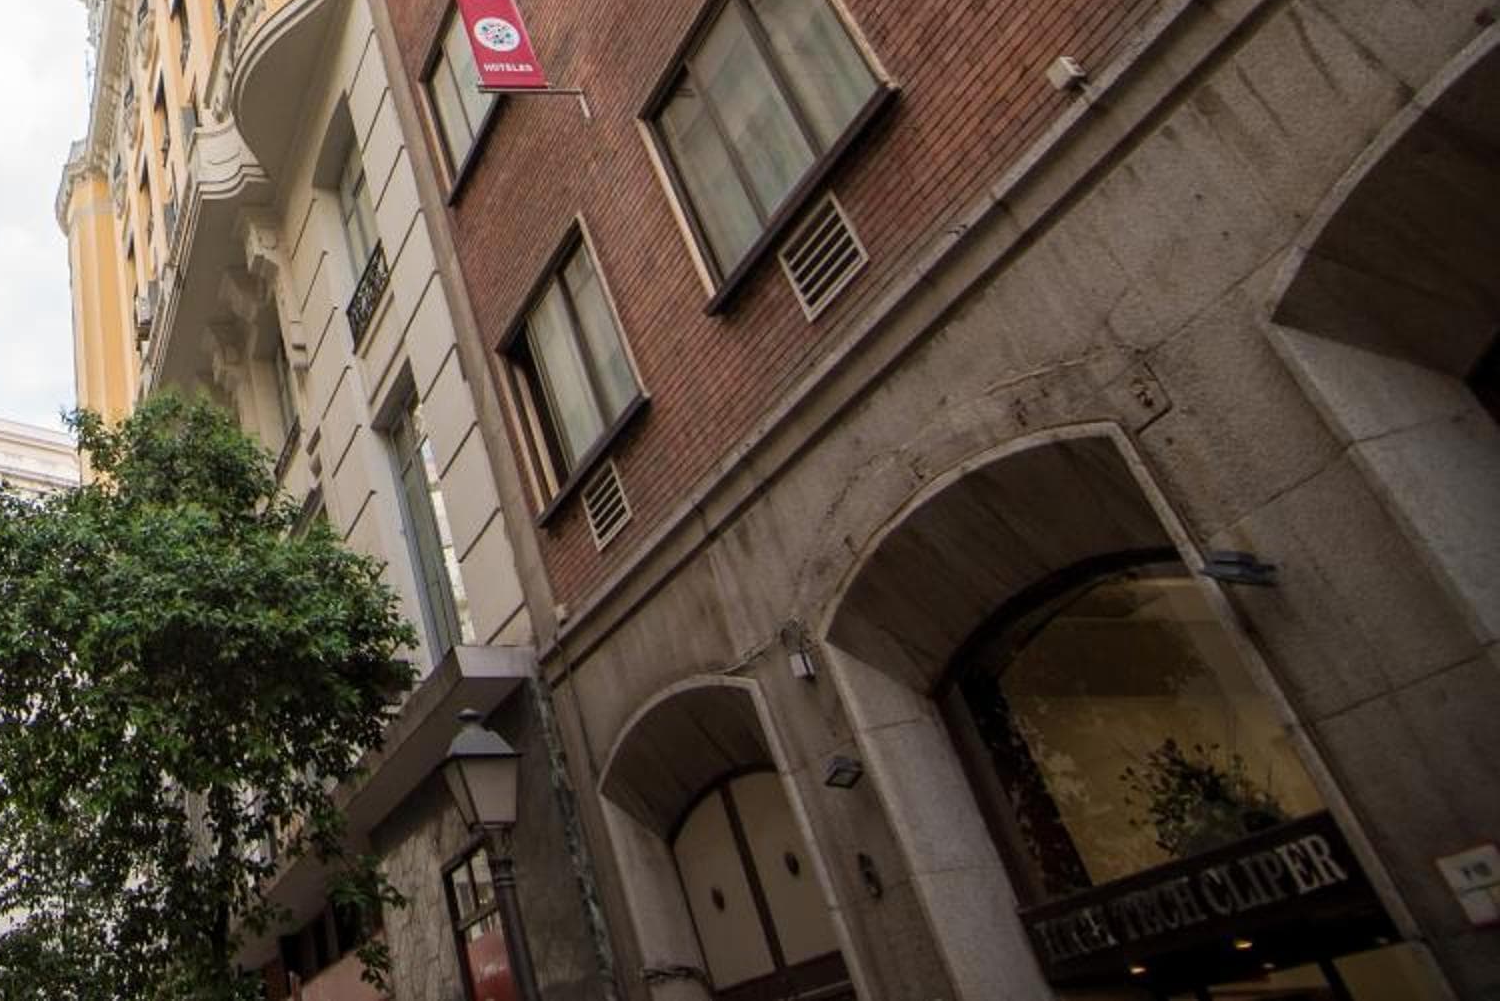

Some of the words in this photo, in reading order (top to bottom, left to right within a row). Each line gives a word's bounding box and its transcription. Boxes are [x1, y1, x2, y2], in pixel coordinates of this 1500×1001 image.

[483, 61, 534, 72] HOTELES
[1111, 875, 1208, 942] TECH
[1200, 833, 1348, 916] CLIPER
